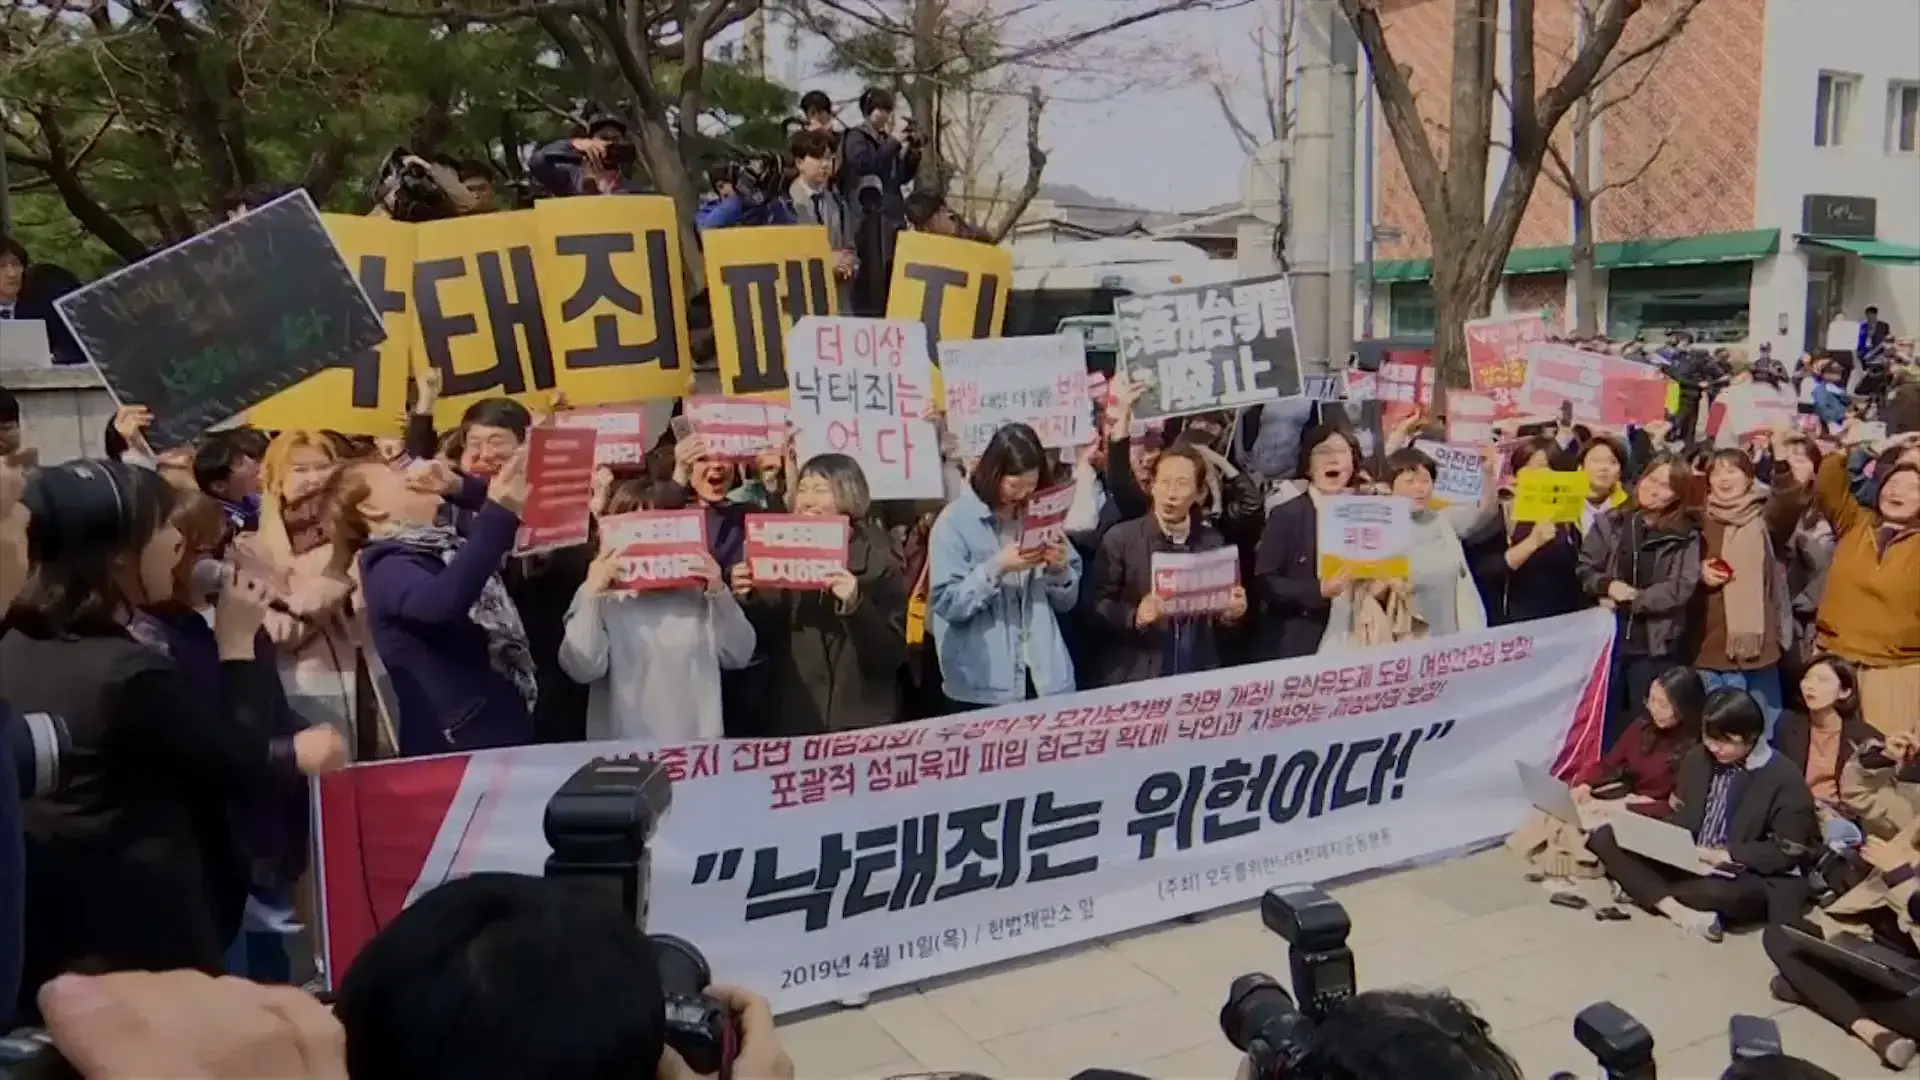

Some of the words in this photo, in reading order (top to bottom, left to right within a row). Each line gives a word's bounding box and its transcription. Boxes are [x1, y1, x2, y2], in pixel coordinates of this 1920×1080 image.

[816, 325, 843, 366] 더
[854, 323, 904, 367] 이상
[796, 367, 922, 418] 낙태죄는
[771, 764, 855, 811] 포괄적
[867, 746, 971, 792] 성교육과
[978, 739, 1028, 774] 피임
[1037, 729, 1110, 764] 접근권
[1178, 713, 1242, 740] 낙인과
[780, 952, 851, 989] 2019년
[858, 944, 891, 970] 4월
[898, 926, 968, 961] 11일(목)
[988, 905, 1072, 942] 헌법재판소
